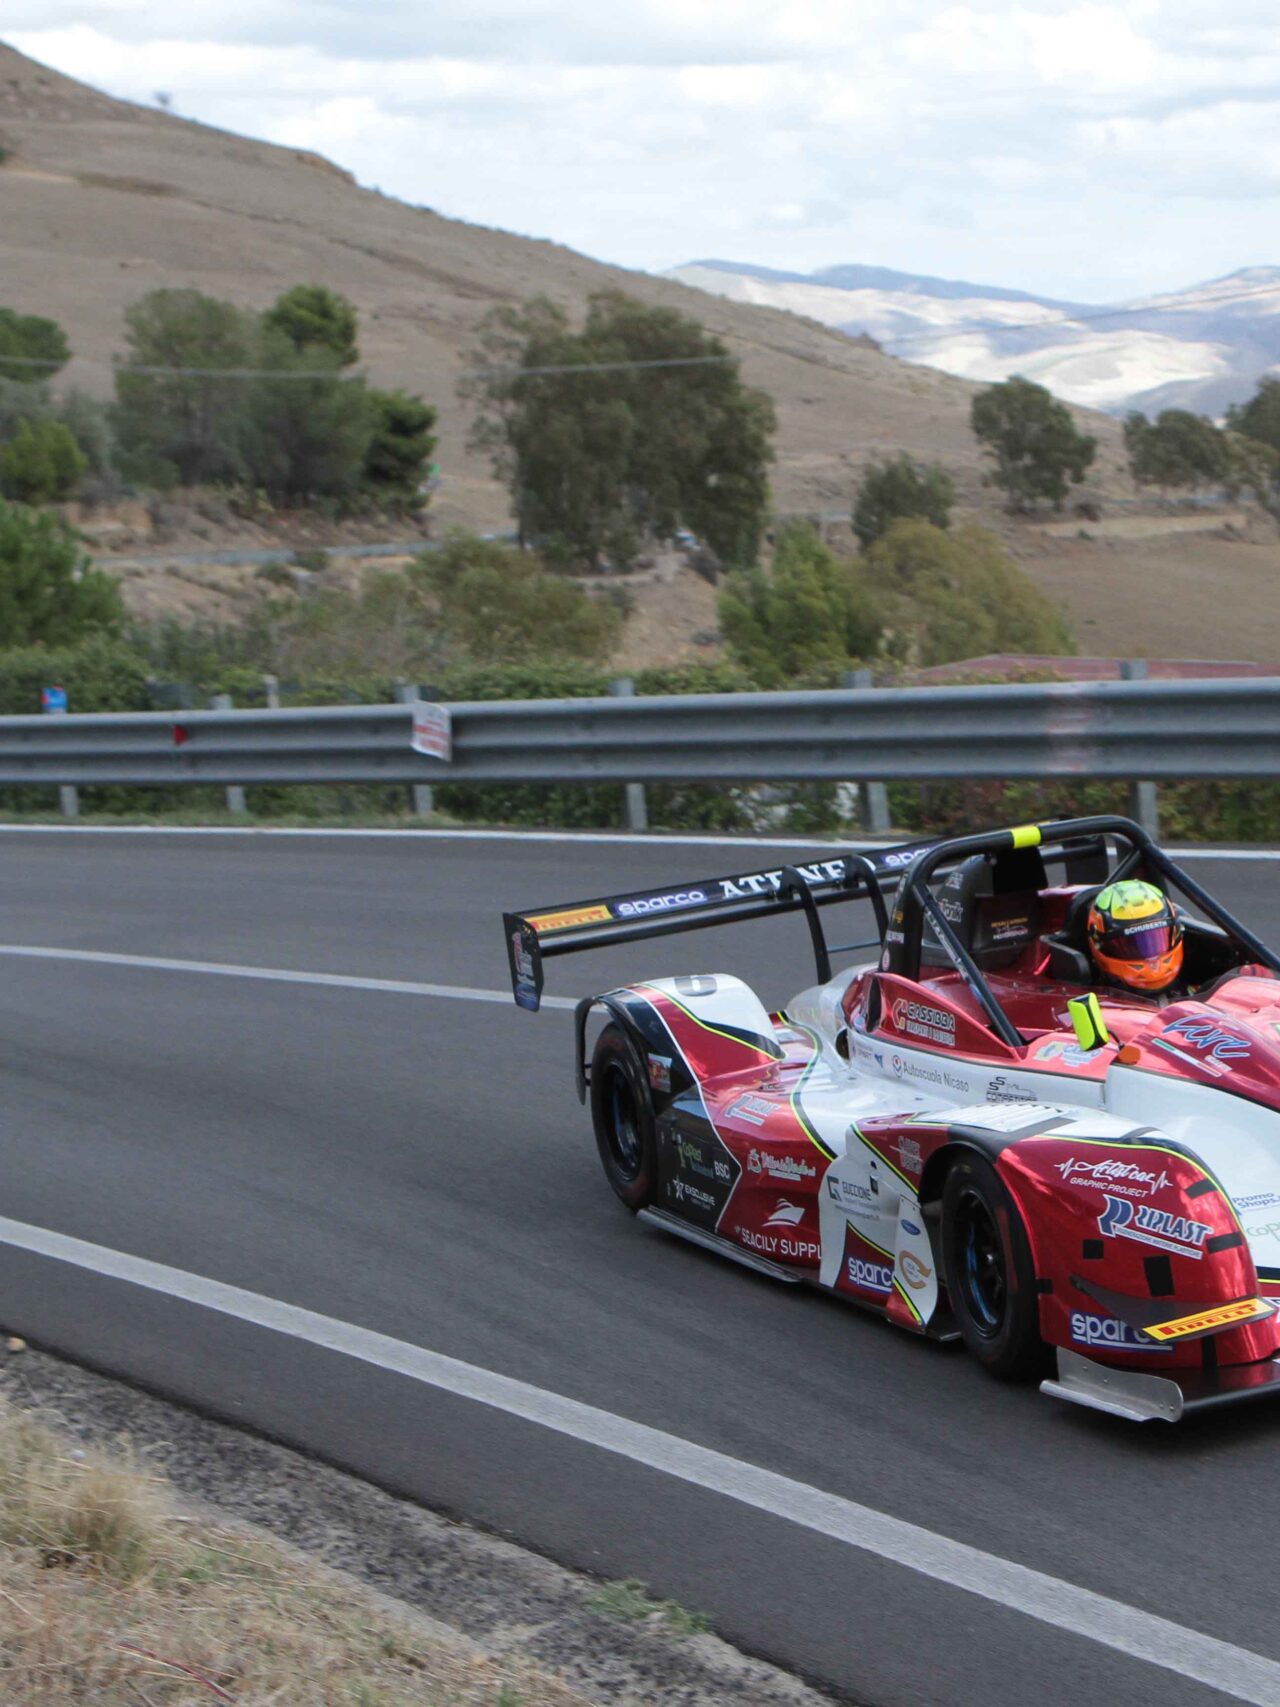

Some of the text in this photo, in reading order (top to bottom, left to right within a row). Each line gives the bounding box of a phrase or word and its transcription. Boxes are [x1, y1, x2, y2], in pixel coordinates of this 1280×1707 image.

[618, 890, 705, 915] sparco
[902, 1061, 970, 1093] Autoscuola Nicaso
[714, 1160, 730, 1179] BSC
[1069, 1176, 1150, 1198] GRAPHIC PROJECT
[1230, 1192, 1275, 1204] Promo
[741, 1228, 779, 1253] SEACILY
[1157, 1302, 1259, 1335] PIRELLI
